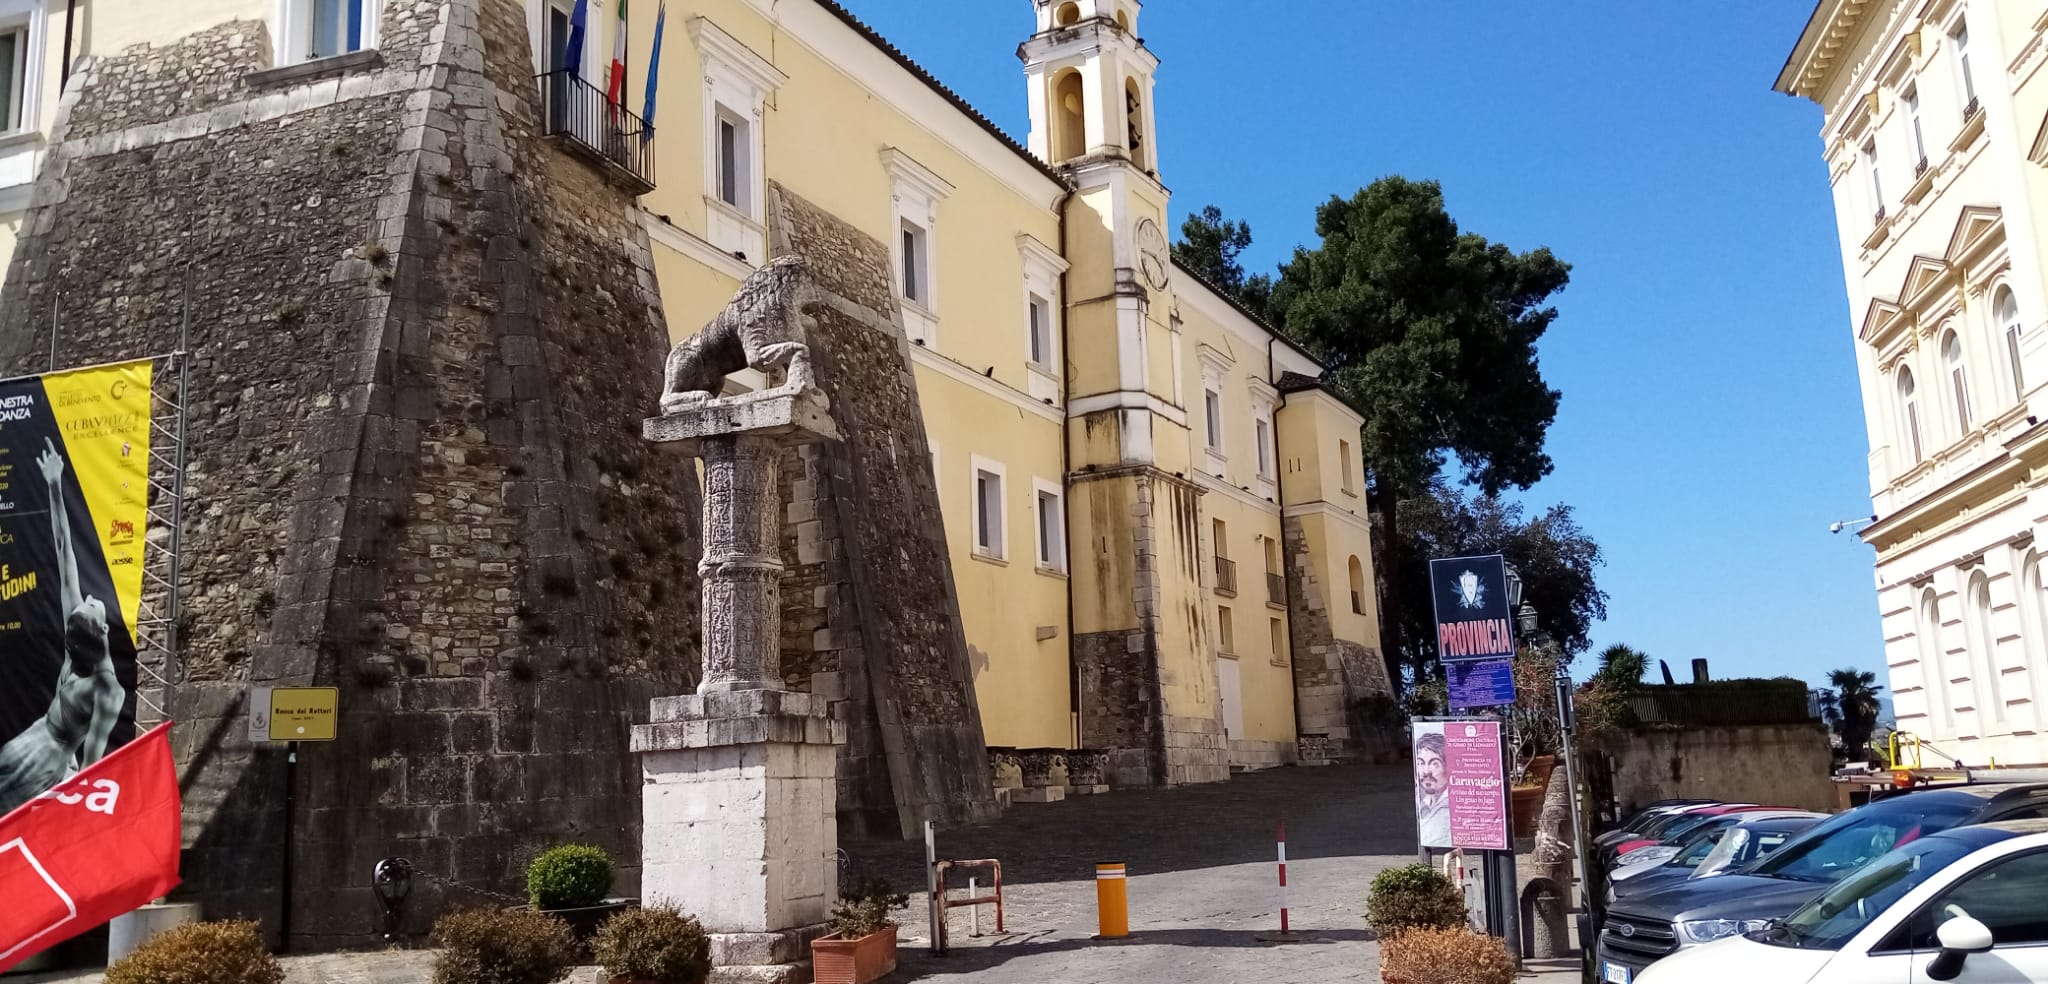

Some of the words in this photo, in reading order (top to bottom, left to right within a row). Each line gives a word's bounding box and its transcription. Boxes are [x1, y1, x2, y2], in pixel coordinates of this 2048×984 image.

[74, 426, 138, 440] EXCELLENCE
[0, 571, 37, 600] UDINI
[1440, 618, 1512, 657] PROVINCIA
[1449, 775, 1500, 790] Caravaggio
